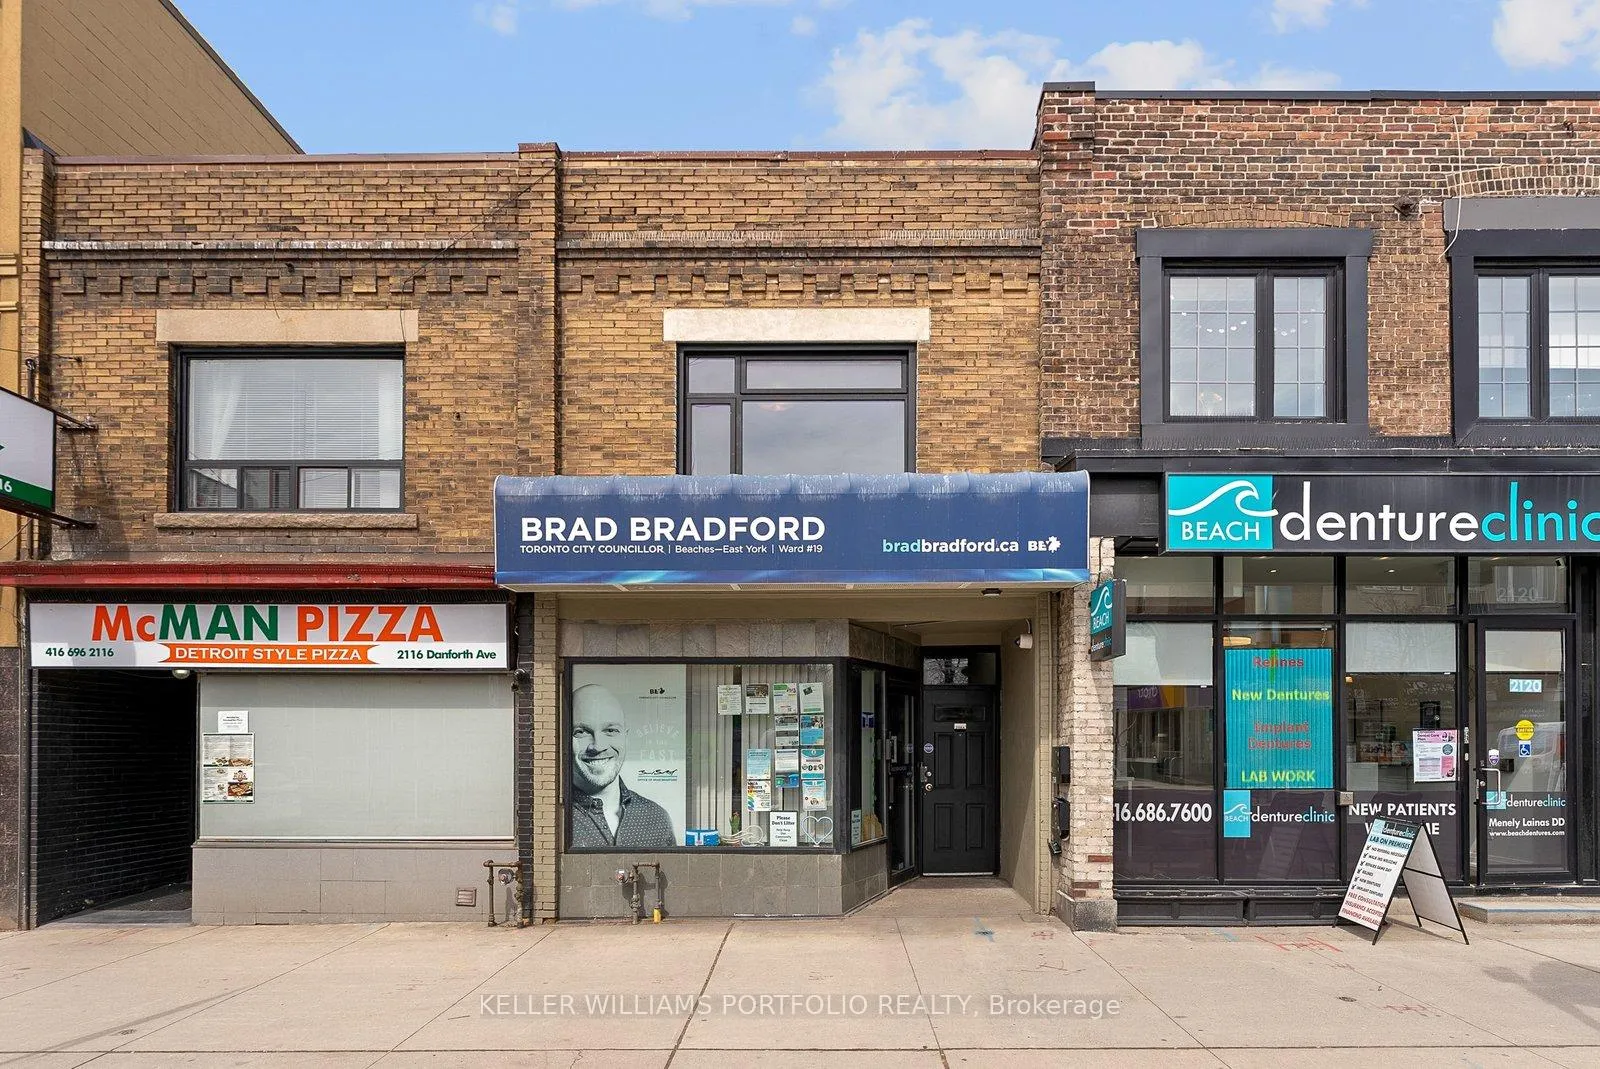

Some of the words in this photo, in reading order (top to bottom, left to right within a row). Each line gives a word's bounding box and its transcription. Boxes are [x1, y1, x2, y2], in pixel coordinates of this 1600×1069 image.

[1279, 481, 1600, 542] dentureclinic
[521, 517, 618, 542] BRAD
[630, 516, 826, 542] BRADFORD
[1182, 521, 1260, 541] BEACH
[520, 545, 570, 554] TORONTO
[572, 545, 595, 554] CITY
[598, 545, 664, 554] COUNCILLOR
[745, 545, 767, 554] York
[778, 544, 804, 553] Ward
[806, 545, 823, 553] #19
[882, 538, 1019, 553] bradbradford.ca
[1497, 587, 1538, 601] 2120
[91, 604, 278, 642] McMAN
[297, 605, 444, 642] PIZZA
[1093, 611, 1110, 630] BEACH
[45, 647, 65, 657] 416
[67, 647, 86, 657] 696
[89, 648, 115, 657] 2116
[175, 647, 249, 660] DETROIT
[252, 648, 308, 660] STYLE
[311, 648, 362, 660] PIZZA
[397, 649, 424, 660] 2116
[426, 649, 473, 660] Danforth
[475, 650, 497, 660] Ave
[1510, 679, 1542, 692] 2120
[1232, 688, 1262, 701] New
[1267, 688, 1330, 701] Dentures
[1248, 737, 1311, 749] Dentures
[1241, 770, 1268, 783] LAB
[1272, 770, 1316, 782] WORK
[1506, 794, 1566, 807] dentureclinic
[1113, 802, 1213, 822] 16.686.7600
[1251, 806, 1335, 822] dentureclinic
[1349, 803, 1382, 816] NEW
[1387, 803, 1457, 816] PATIENTS
[1488, 818, 1520, 829] Menely
[1522, 818, 1550, 827] Lainas
[1552, 817, 1566, 827] DD
[1382, 823, 1416, 839] dentureclinic
[1489, 829, 1565, 837] www.beachdentures.com
[1388, 839, 1411, 850] PREMISES
[1348, 891, 1358, 900] FREE
